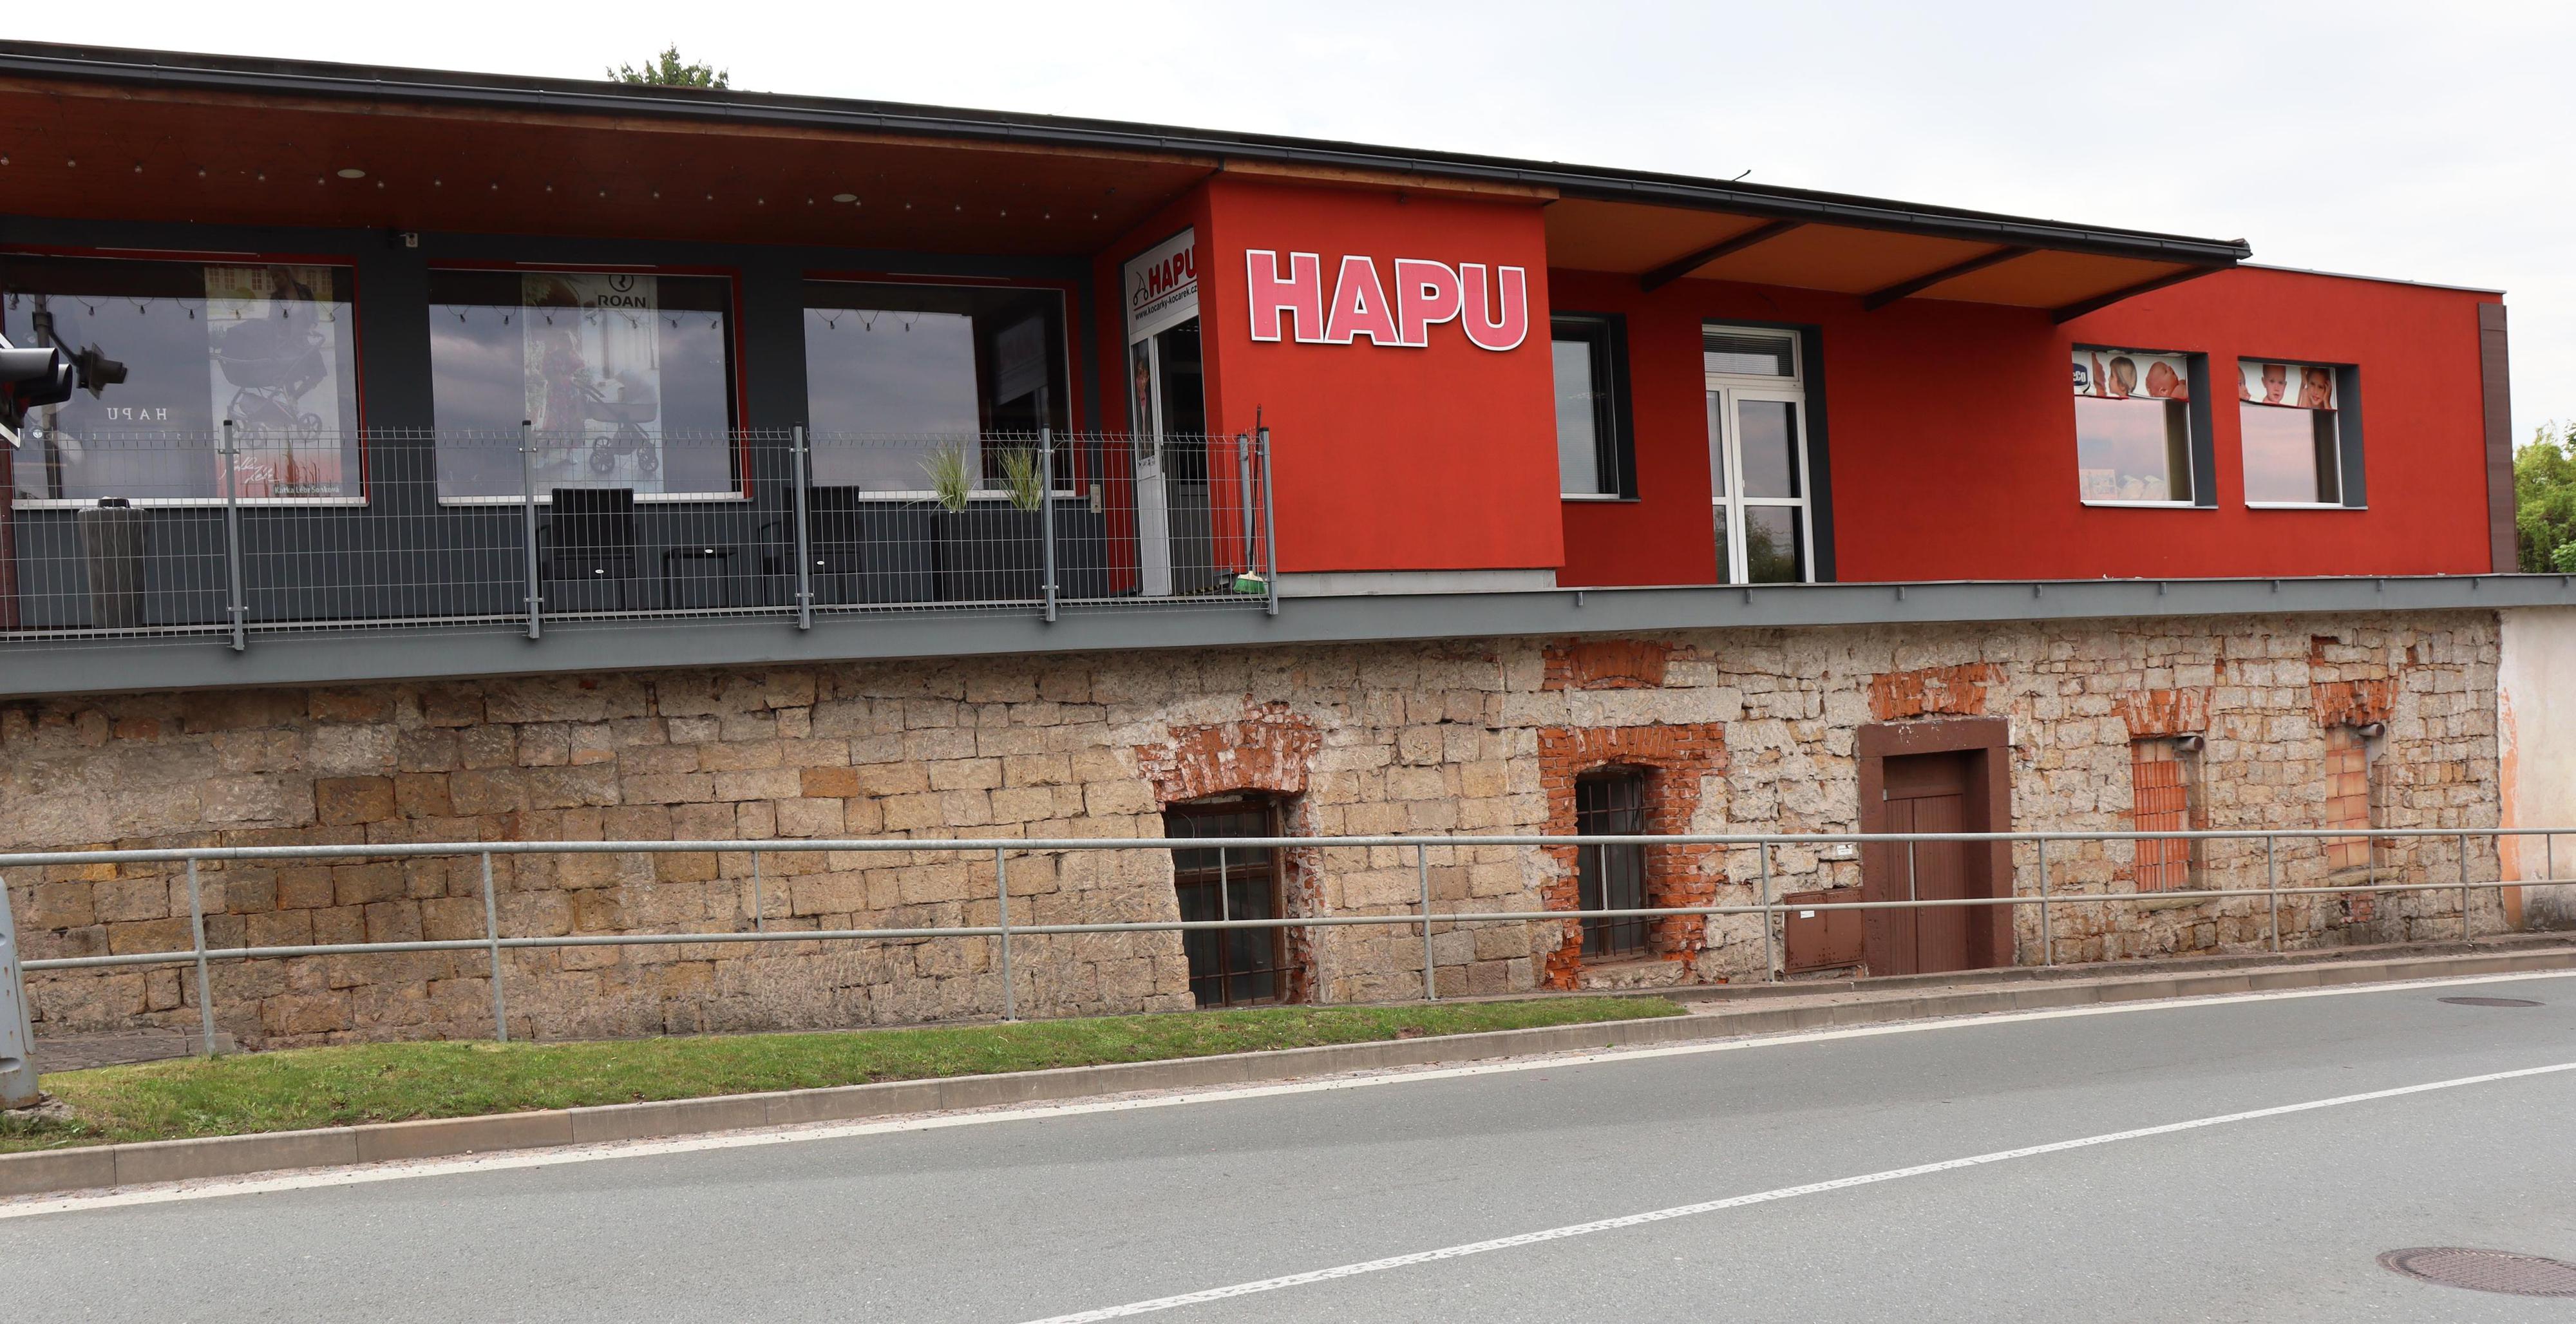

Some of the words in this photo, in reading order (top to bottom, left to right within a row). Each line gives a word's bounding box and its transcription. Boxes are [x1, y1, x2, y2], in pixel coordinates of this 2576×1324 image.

[1148, 245, 1197, 298] HAPU
[598, 295, 646, 308] ROAN
[1135, 285, 1197, 320] www.kocarky-kocarek.cz
[1246, 249, 1528, 351] HAPU
